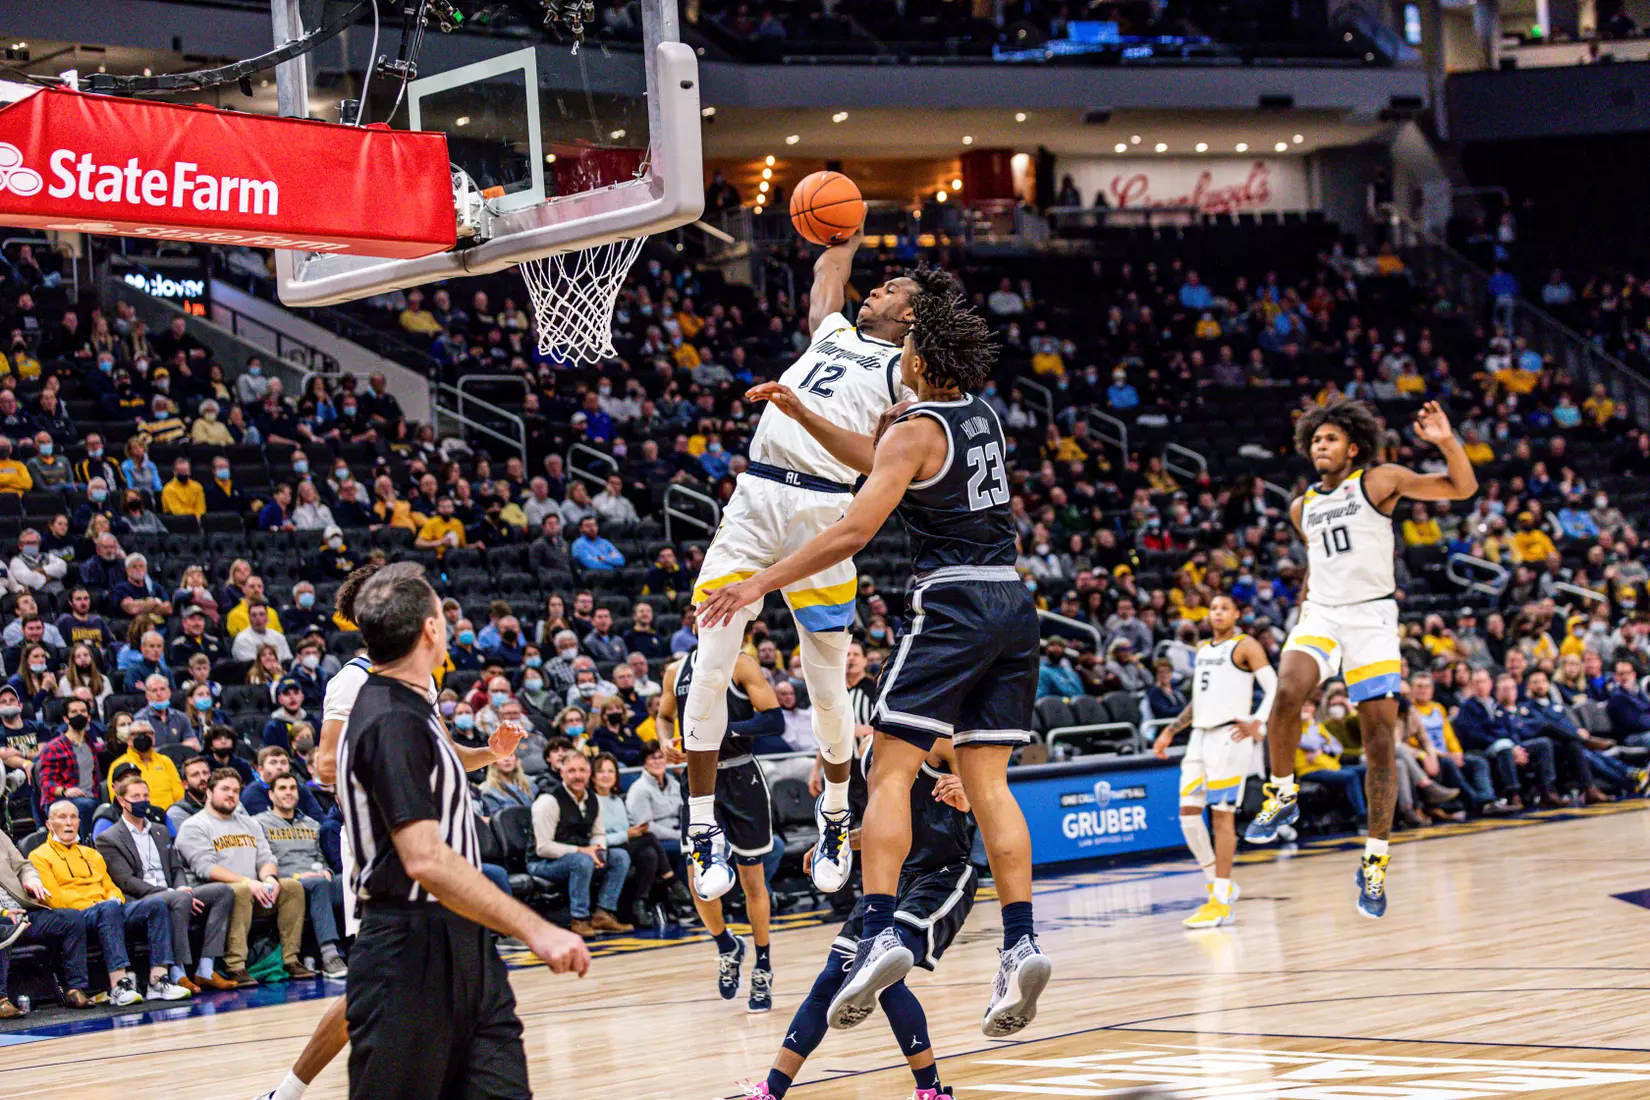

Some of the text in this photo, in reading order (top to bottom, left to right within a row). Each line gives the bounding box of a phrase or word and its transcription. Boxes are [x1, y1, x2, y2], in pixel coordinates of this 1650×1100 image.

[810, 340, 881, 371] Marquette
[798, 360, 848, 398] 12
[966, 441, 1011, 512] 23
[1307, 501, 1361, 527] Marquette
[1322, 525, 1351, 558] 10
[1201, 671, 1211, 692] 5
[268, 828, 317, 841] MARQUETTE
[1062, 805, 1147, 839] GRUBER
[212, 834, 257, 851] MARQUETTE
